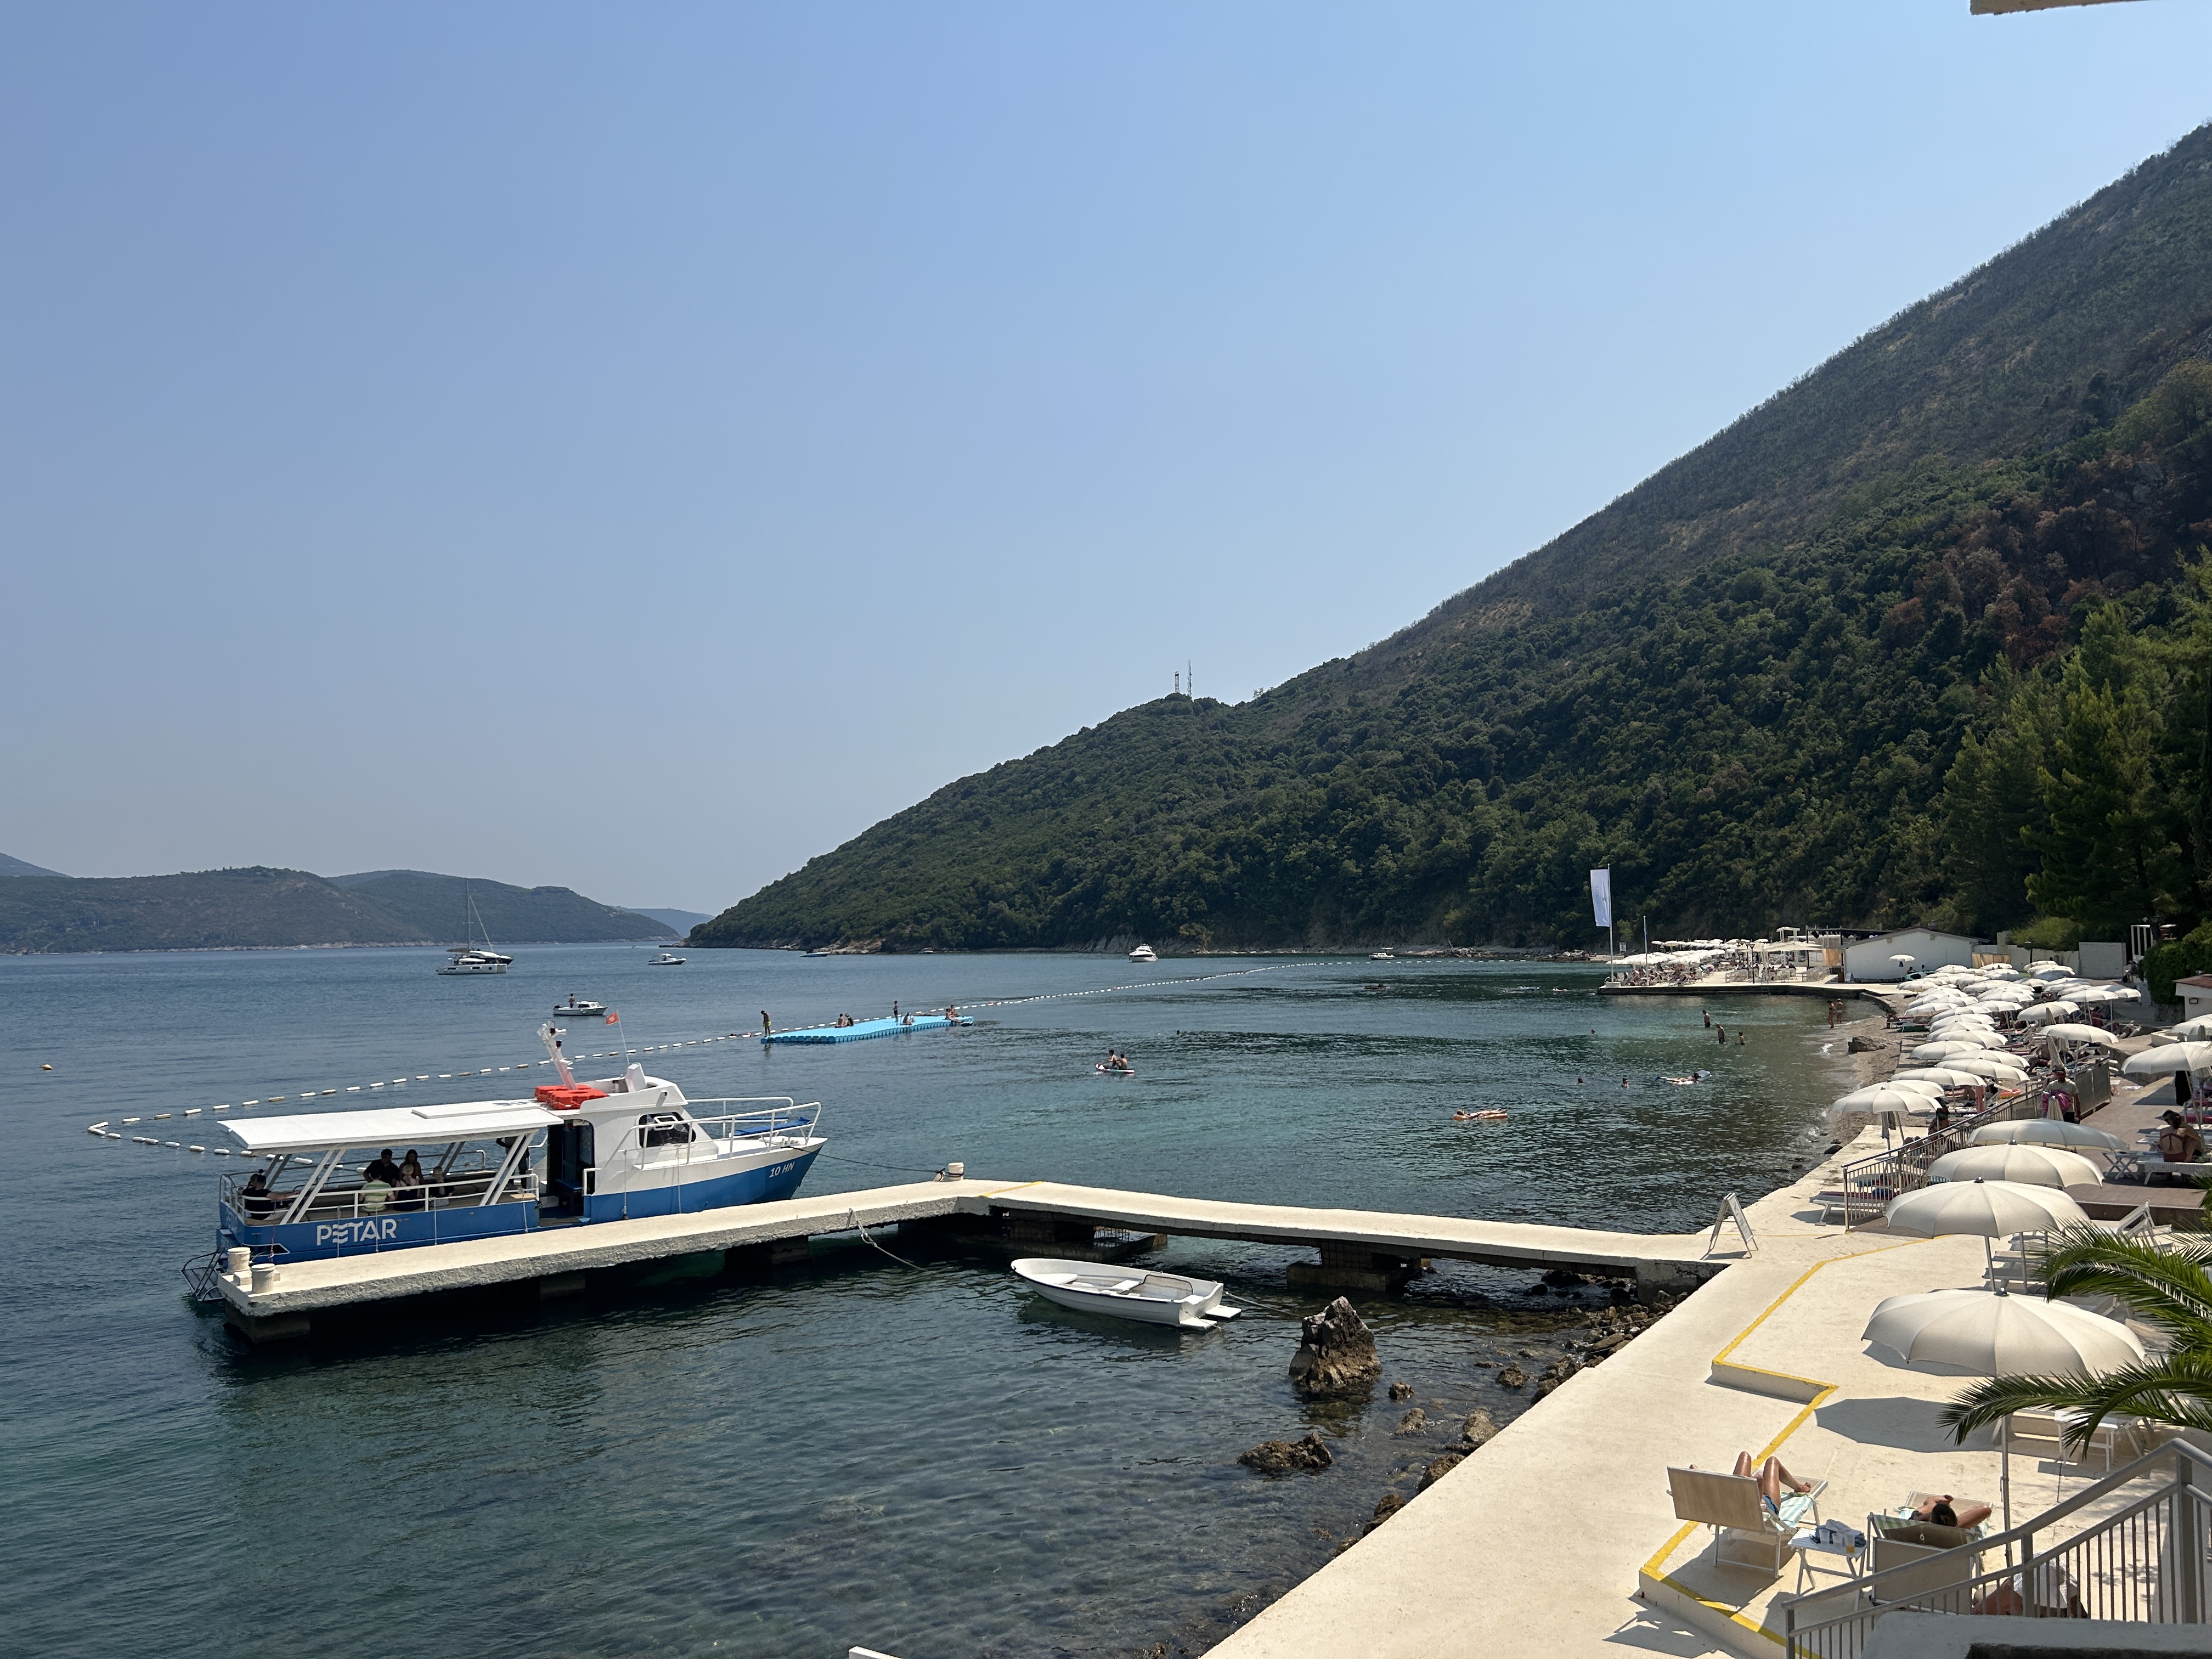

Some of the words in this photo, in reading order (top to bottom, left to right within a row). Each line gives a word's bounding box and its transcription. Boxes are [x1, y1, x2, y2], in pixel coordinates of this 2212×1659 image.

[769, 1166, 781, 1178] 10
[781, 1160, 795, 1174] HN
[316, 1218, 397, 1246] PETAR
